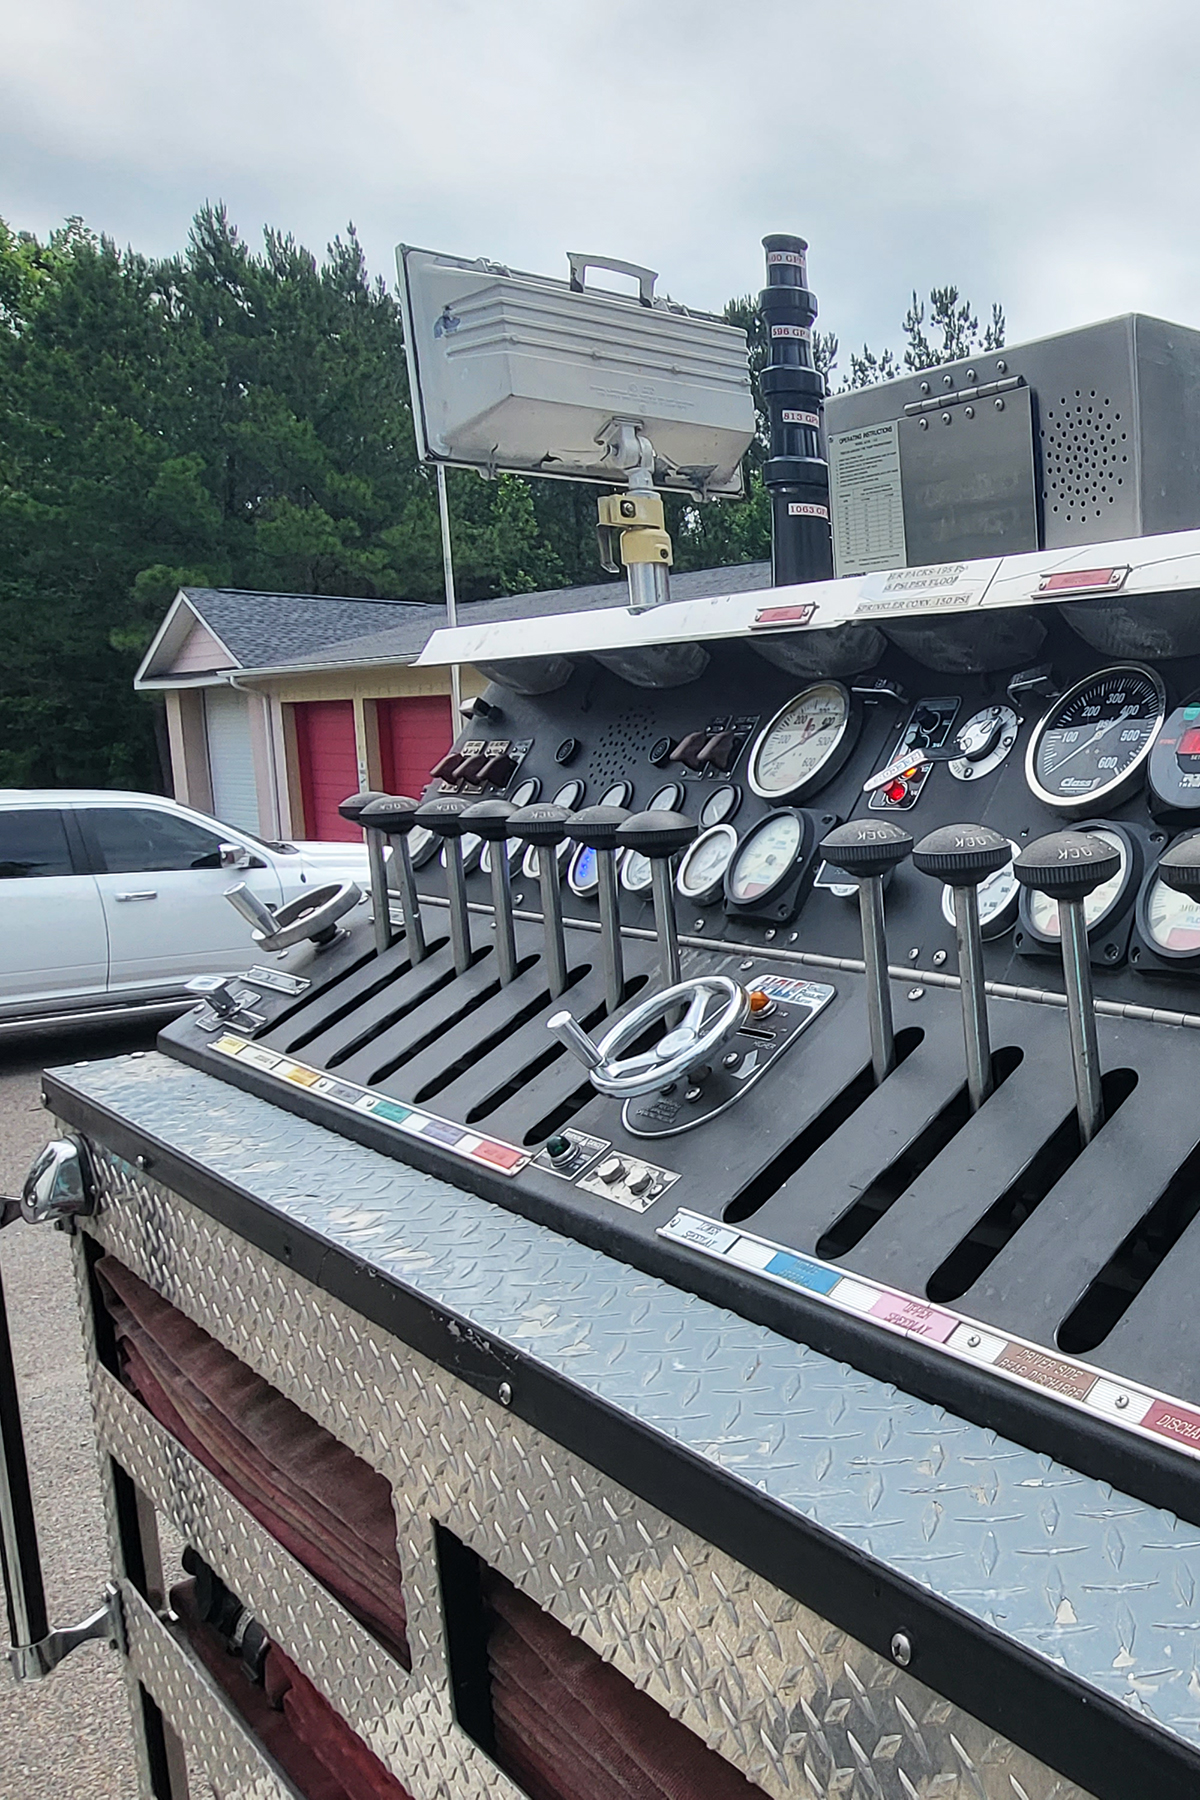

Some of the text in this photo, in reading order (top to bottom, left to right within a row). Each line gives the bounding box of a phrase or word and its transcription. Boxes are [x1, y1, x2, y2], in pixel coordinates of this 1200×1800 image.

[783, 412, 803, 422] 813
[790, 505, 815, 514] 1063
[1106, 692, 1126, 704] 300
[1081, 705, 1101, 717] 200
[1120, 704, 1140, 716] 400
[1061, 731, 1079, 743] 100
[1120, 729, 1140, 741] 500
[1097, 756, 1118, 769] 600
[1016, 1349, 1085, 1382] DRIVER SIDE
[998, 1357, 1085, 1400] REAR DISCHARGE
